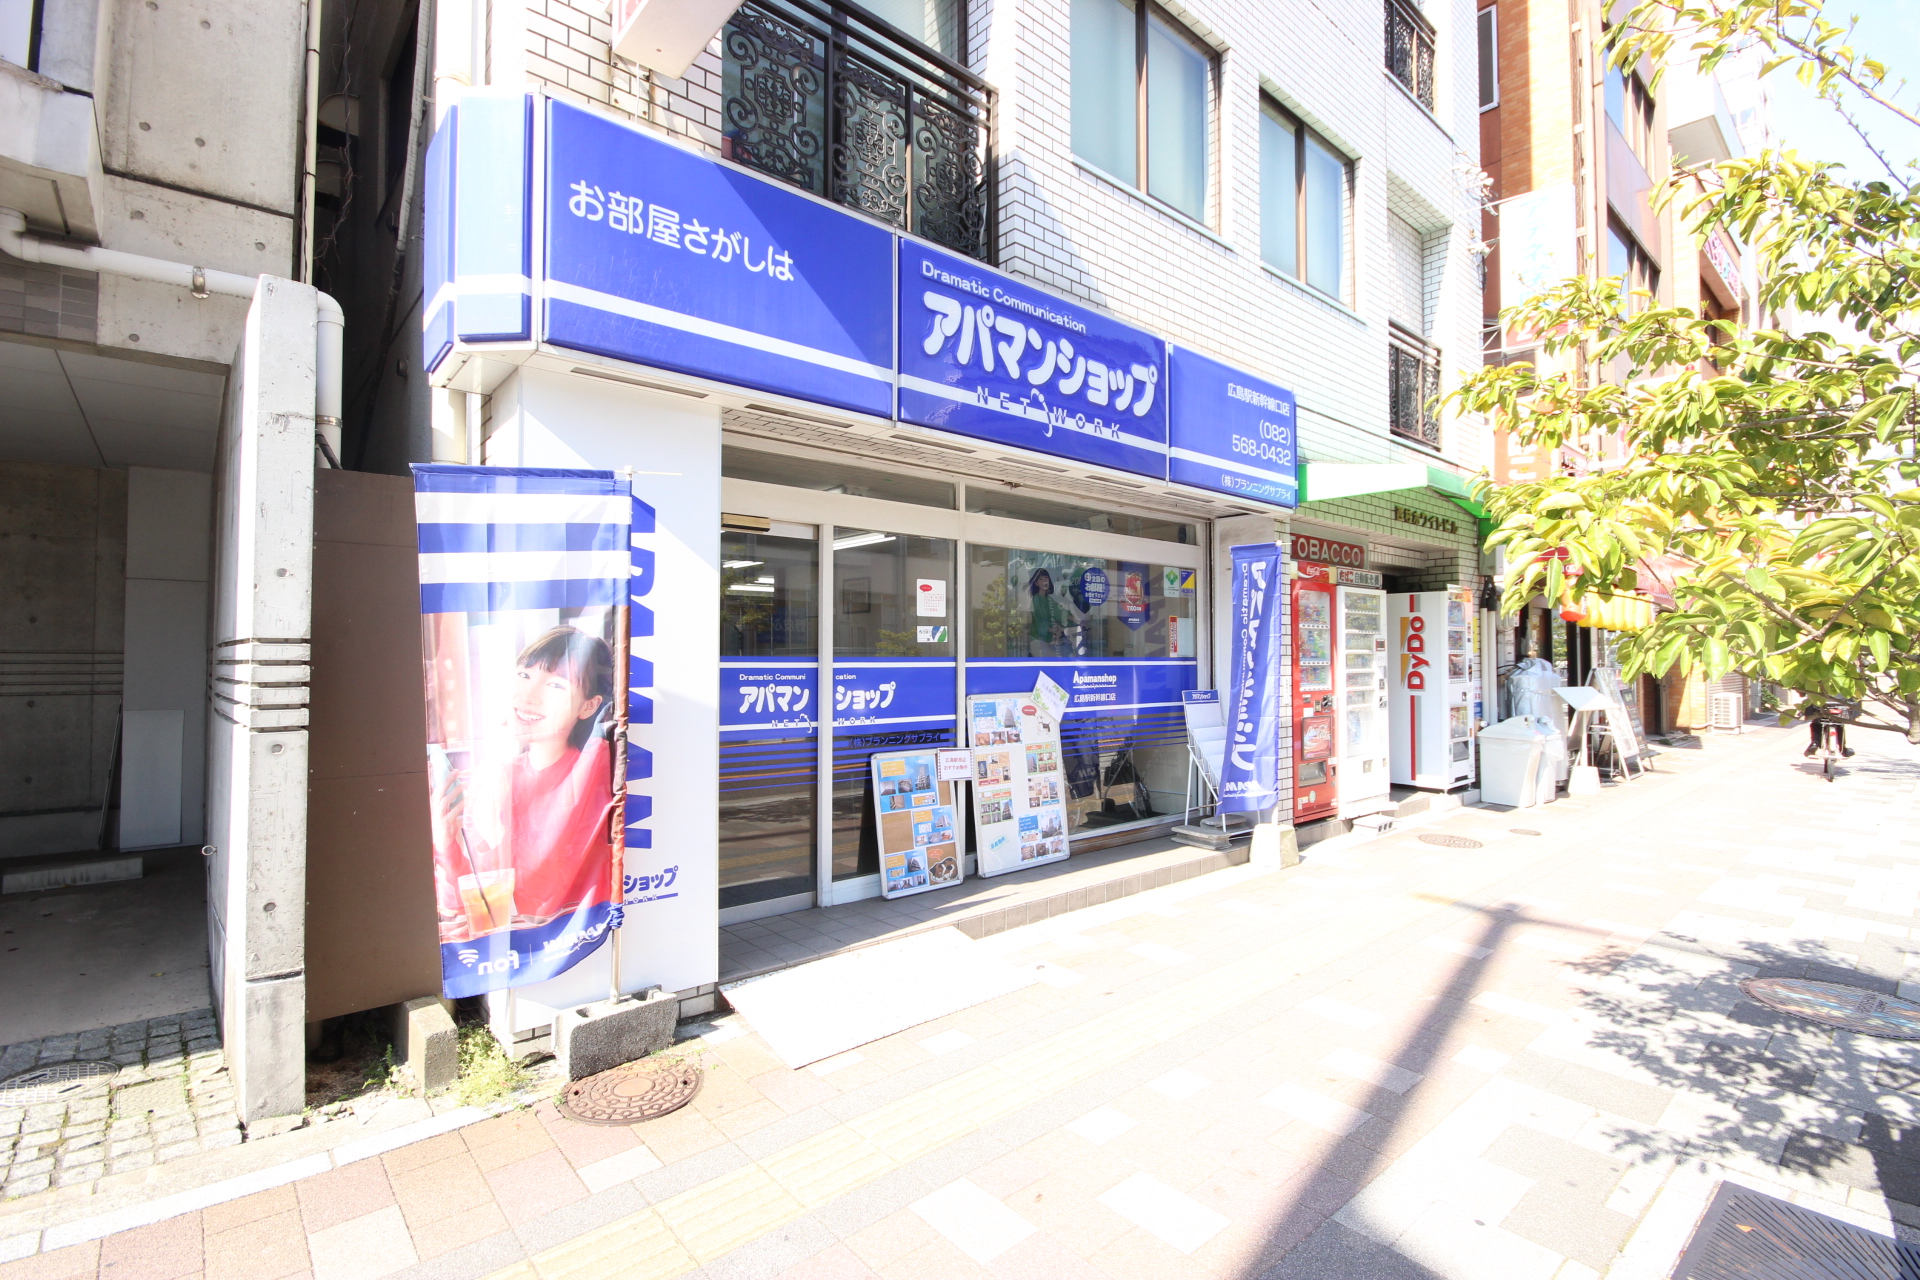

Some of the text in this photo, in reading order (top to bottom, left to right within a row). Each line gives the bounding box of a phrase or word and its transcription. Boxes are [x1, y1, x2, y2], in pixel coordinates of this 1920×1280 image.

[568, 179, 795, 282] お部屋さがしは
[1520, 195, 1552, 307] アテネ学
[922, 259, 1087, 336] Dramatic Communication
[923, 291, 1158, 417] アパマンショップ
[1227, 382, 1290, 417] 広島駅新幹線口店
[1259, 419, 1291, 447] (082)
[1232, 433, 1291, 467] 568-0432
[1407, 616, 1430, 690] DyDo
[739, 673, 774, 681] Dramatic
[835, 673, 857, 681] cation
[1073, 670, 1117, 685] Apamanshop
[739, 683, 810, 714] アパマン
[835, 681, 897, 711] ショップ
[771, 719, 801, 728] NET
[837, 715, 877, 725] WORK
